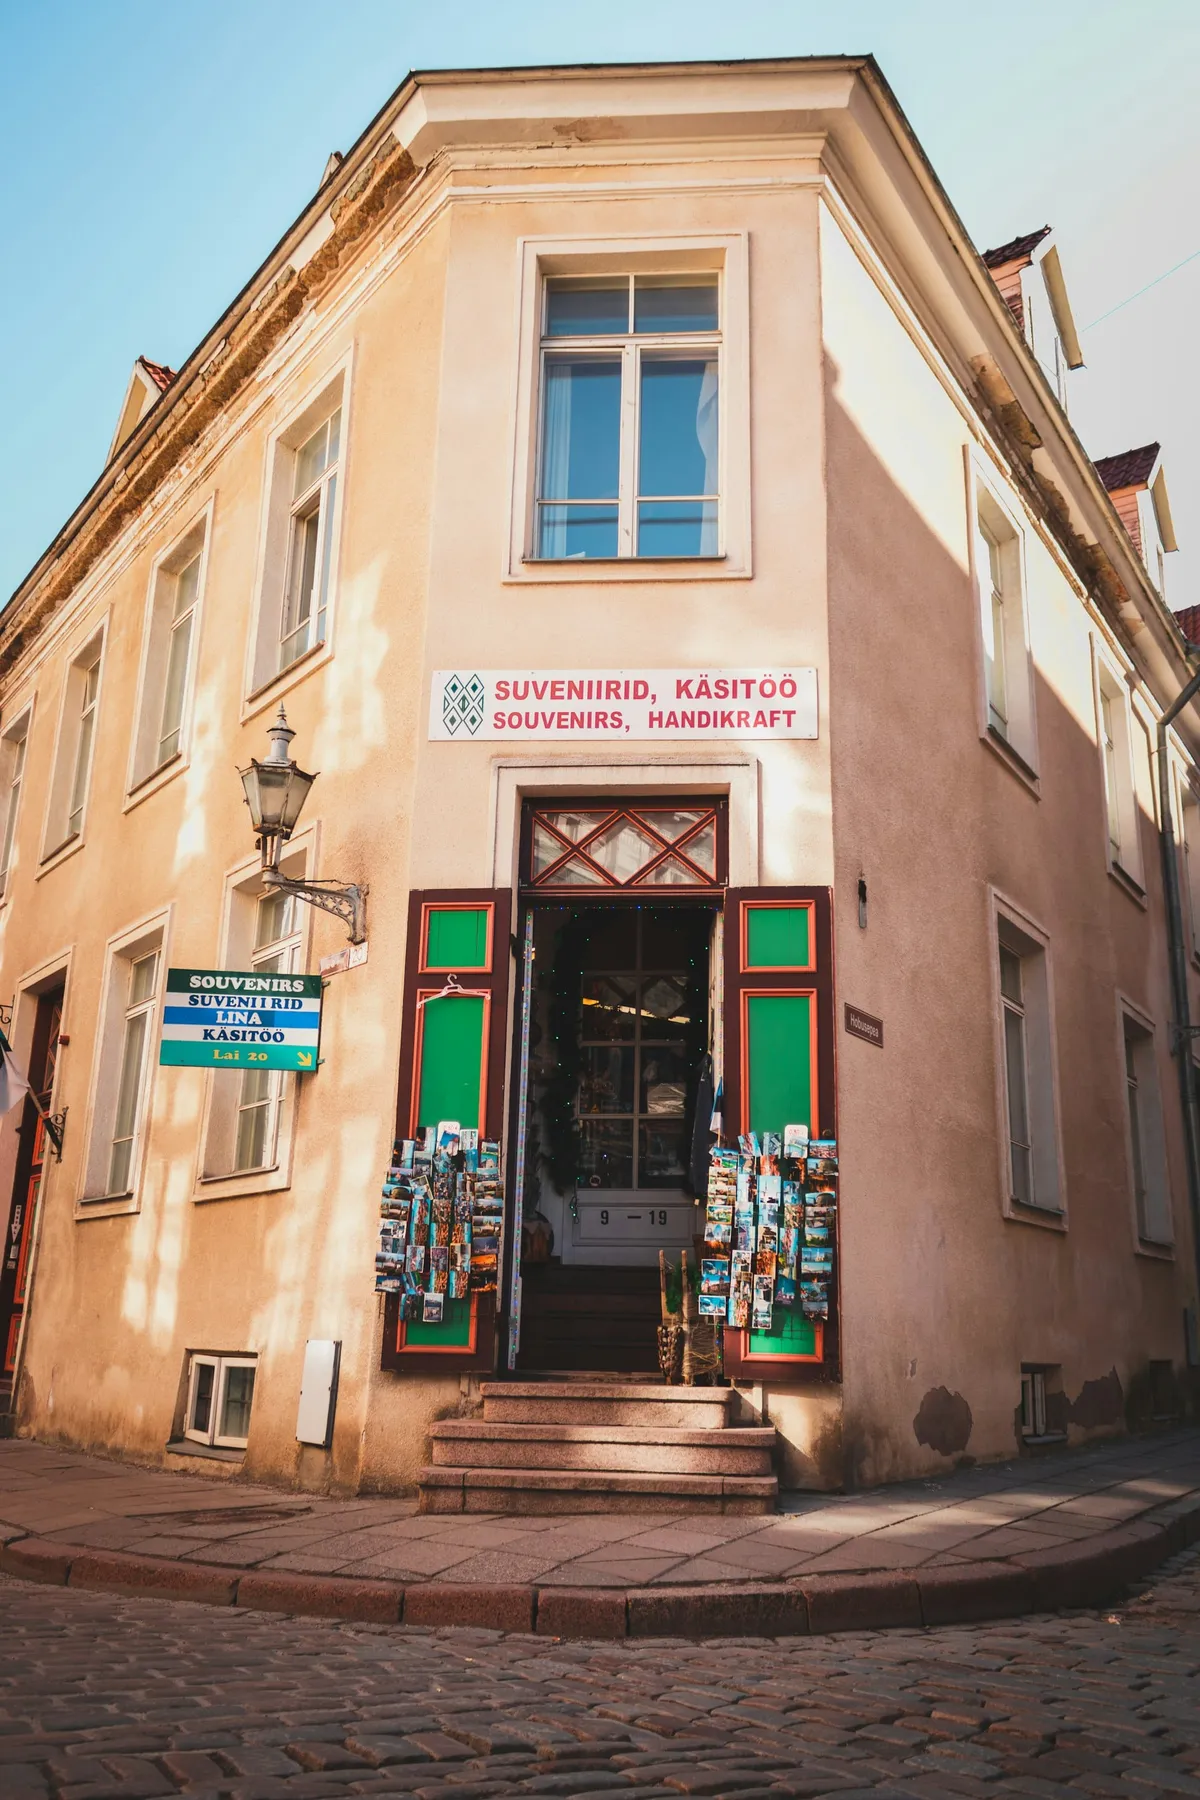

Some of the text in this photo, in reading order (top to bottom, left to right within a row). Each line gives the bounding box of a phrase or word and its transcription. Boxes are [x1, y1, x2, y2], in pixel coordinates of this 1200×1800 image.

[494, 674, 797, 704] SUVENIIRID, KÄSITÖÖ
[492, 709, 797, 733] SOUVENIRS, HANDIKRAFT
[189, 975, 304, 992] SOUVENIRS
[216, 1011, 262, 1025] LINA
[850, 1013, 879, 1038] Hobusepea
[202, 1026, 285, 1043] KÄSITÖÖ
[213, 1049, 268, 1061] Lai 20
[600, 1210, 609, 1225] 9
[649, 1210, 667, 1225] 19
